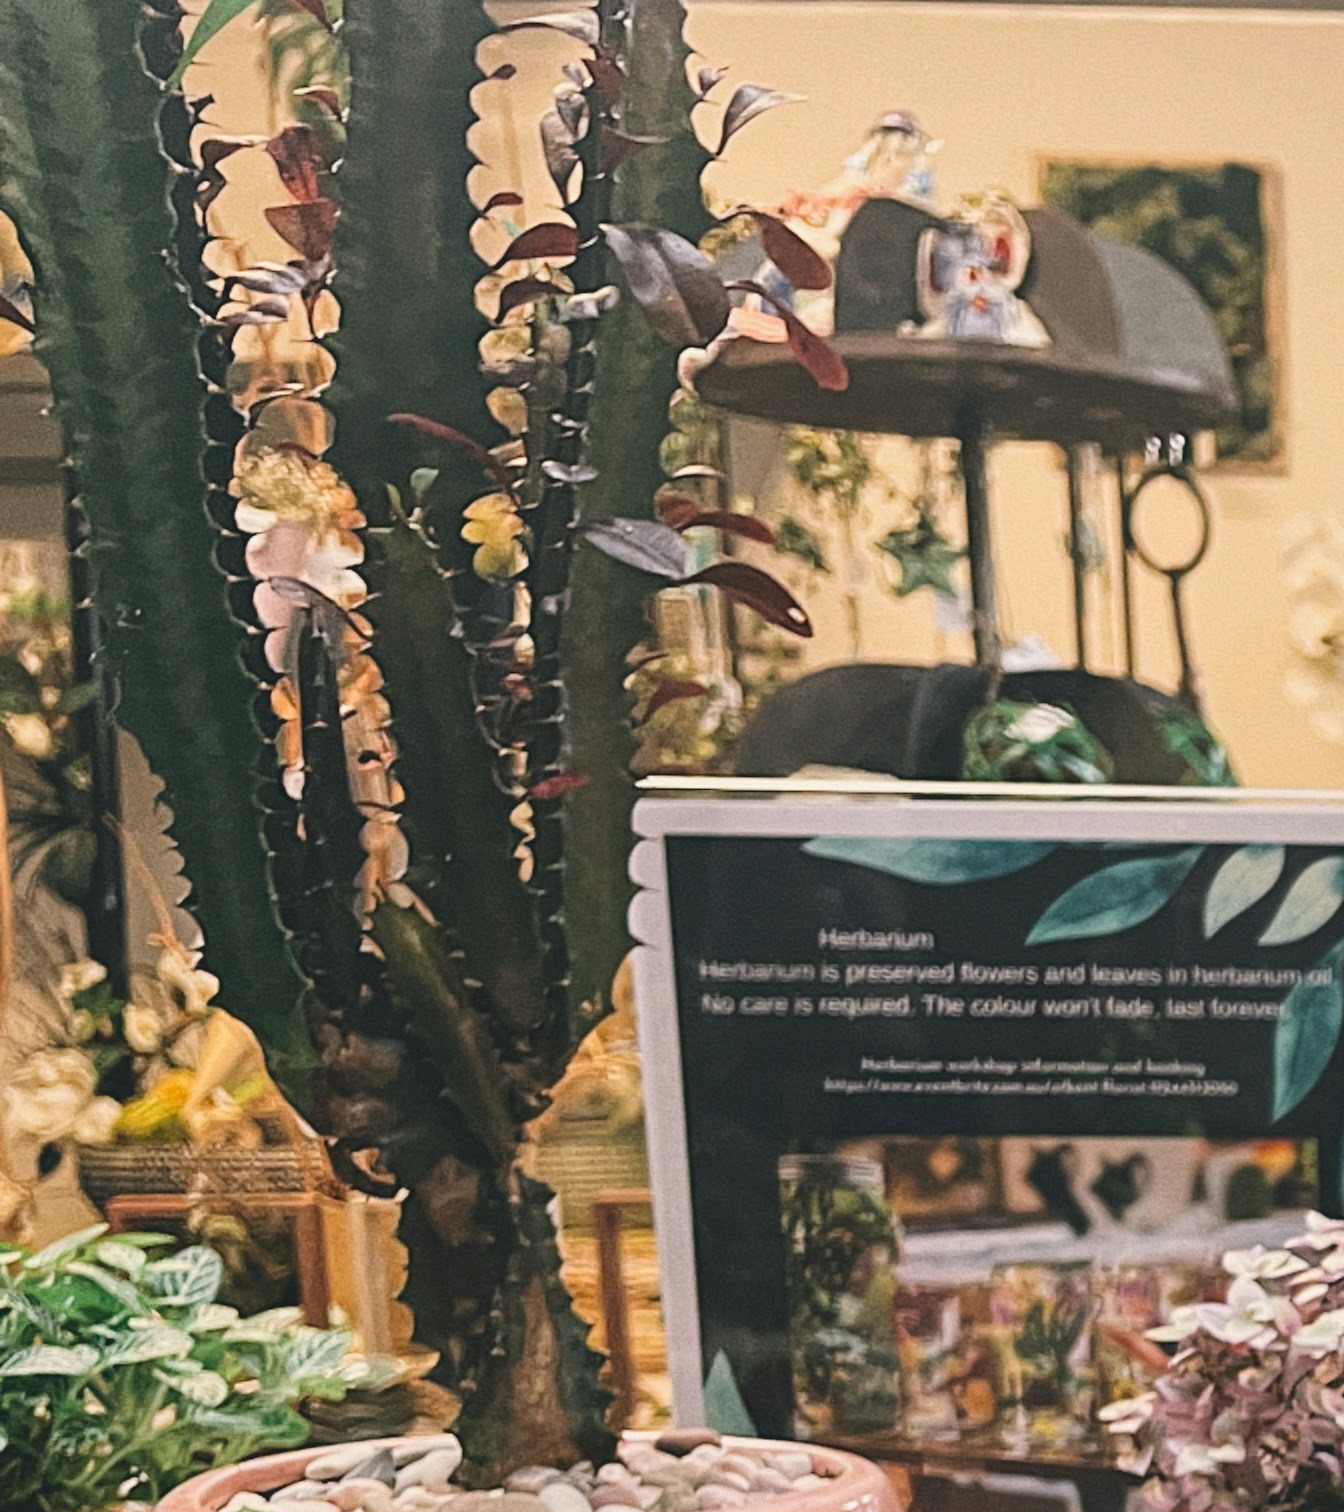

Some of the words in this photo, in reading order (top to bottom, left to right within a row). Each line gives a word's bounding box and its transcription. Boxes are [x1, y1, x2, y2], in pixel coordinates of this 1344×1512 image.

[817, 927, 935, 951] Herbarium
[699, 960, 815, 983] Herbarium
[821, 960, 841, 983] is
[845, 961, 955, 987] preserved
[960, 961, 1039, 985] flowers
[1044, 963, 1086, 986] and
[1091, 963, 1162, 987] leaves
[1168, 965, 1188, 986] in
[1192, 964, 1302, 987] herbarium
[701, 993, 735, 1015] No
[739, 995, 789, 1016] care
[793, 994, 813, 1016] is
[921, 993, 965, 1017] The
[969, 994, 1037, 1018] colour
[1165, 997, 1205, 1018] last
